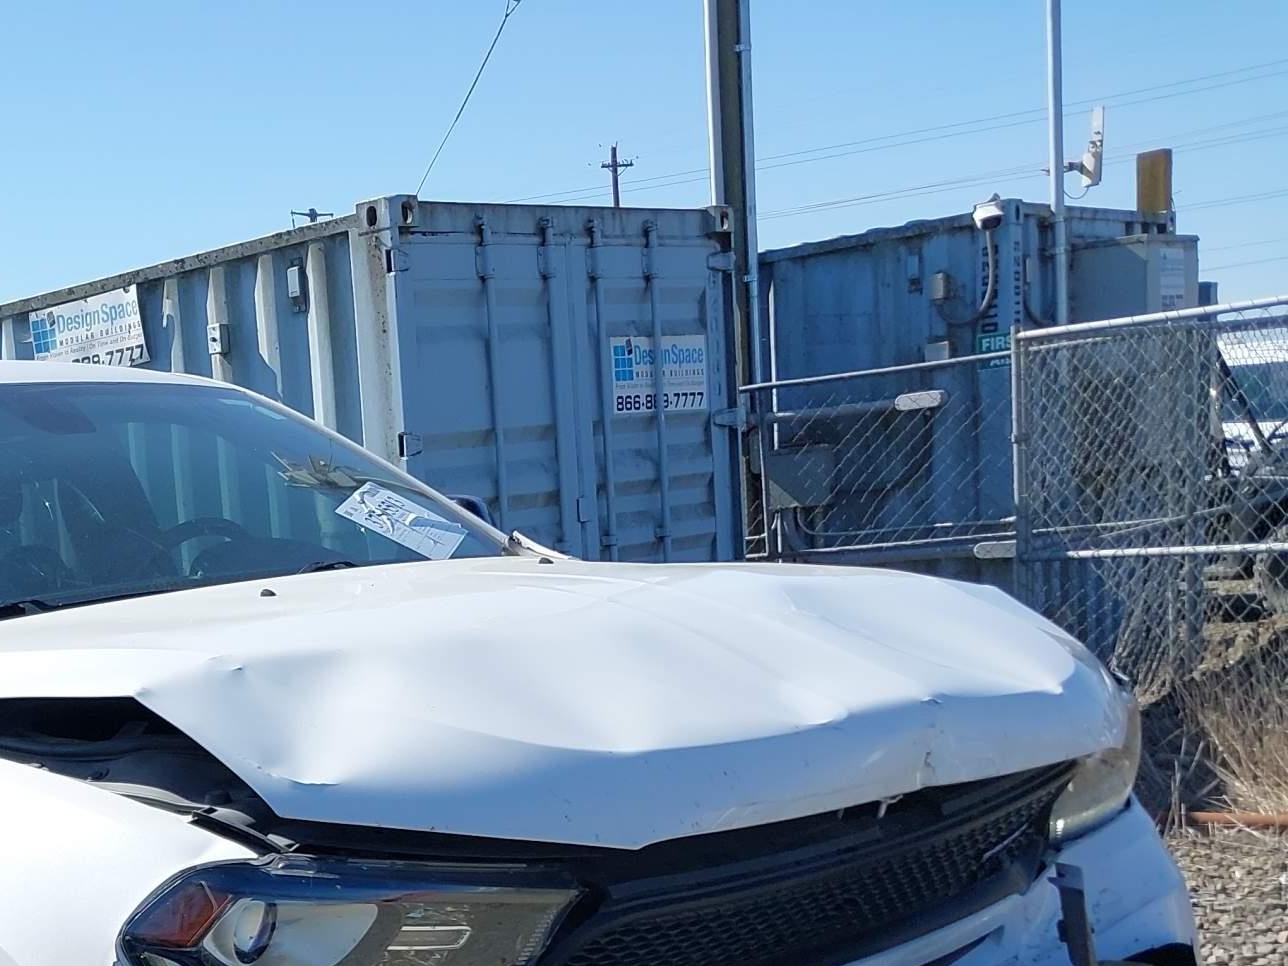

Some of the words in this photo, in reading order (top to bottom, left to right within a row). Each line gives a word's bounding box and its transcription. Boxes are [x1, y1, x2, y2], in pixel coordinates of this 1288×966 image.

[56, 300, 138, 333] DesignSpace
[59, 332, 95, 346] MODULAR
[99, 321, 141, 336] BUILDINGS
[982, 335, 1012, 352] FIRS
[634, 344, 704, 368] DesnSpace
